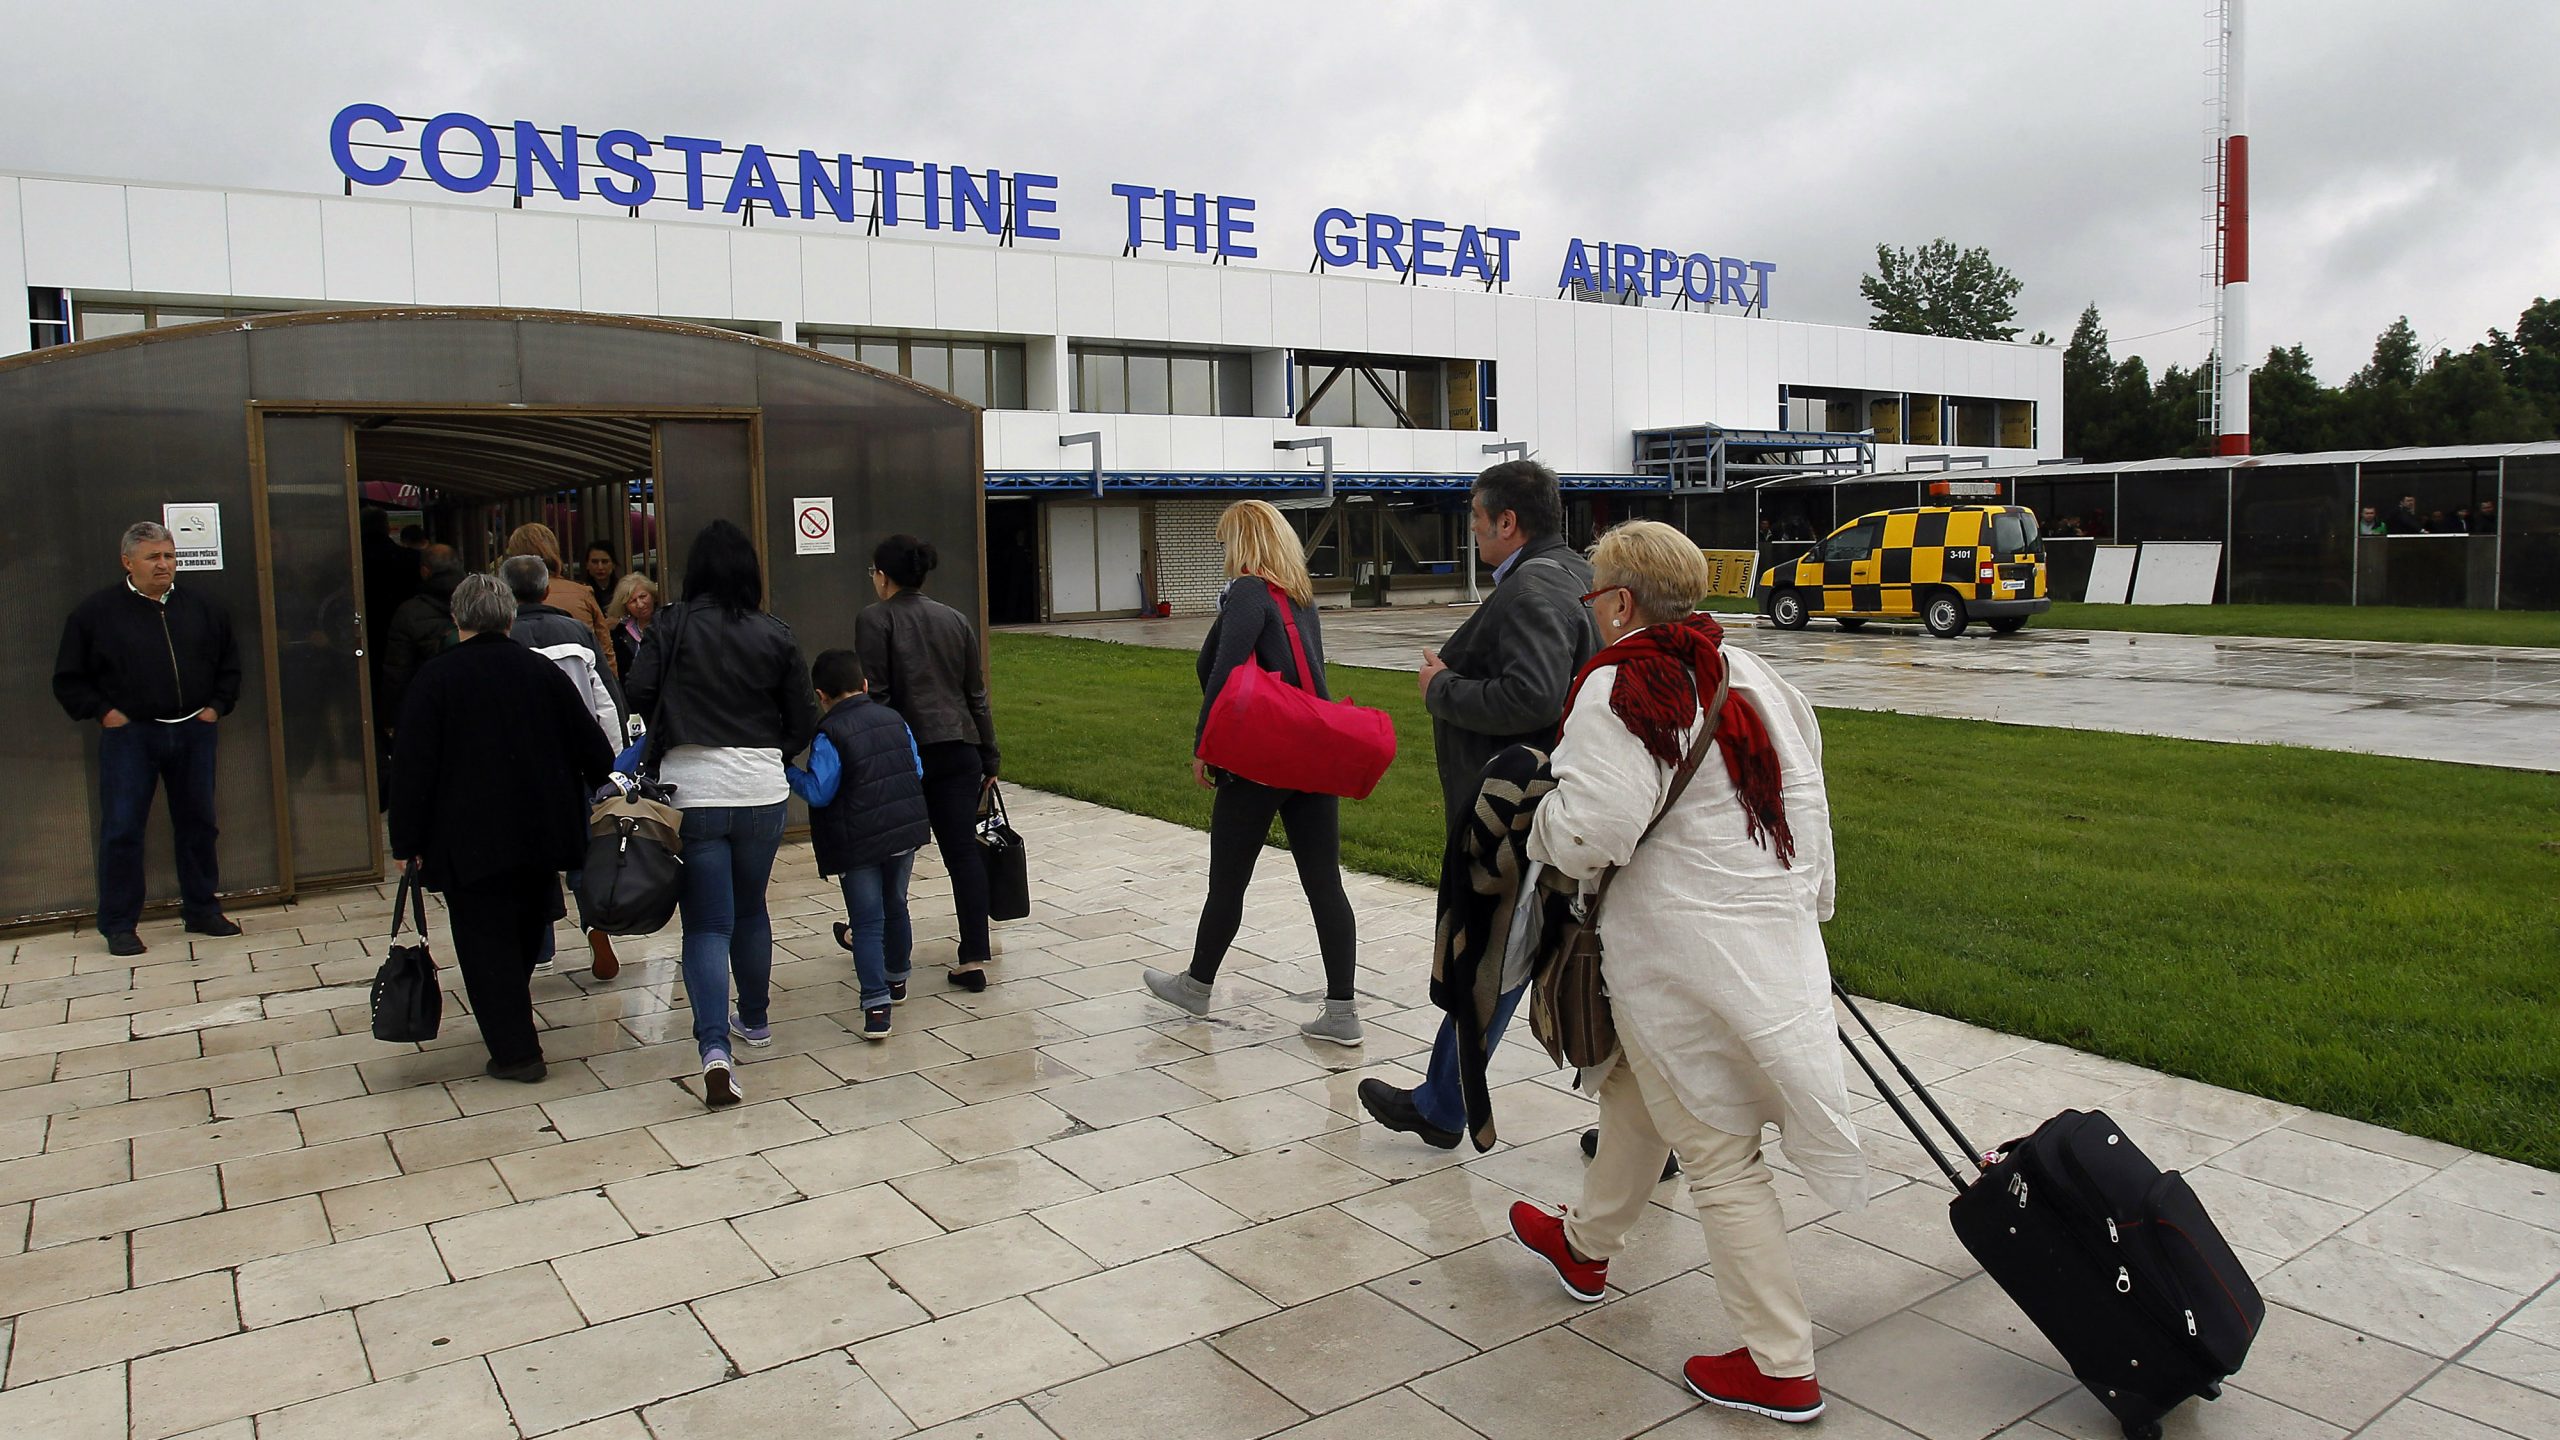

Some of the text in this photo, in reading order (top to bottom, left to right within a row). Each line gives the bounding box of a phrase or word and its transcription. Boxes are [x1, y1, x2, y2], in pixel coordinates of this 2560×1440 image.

[330, 103, 1776, 309] CONSTANTINE THE GREAT AIRPORT
[1950, 550, 1971, 559] 3-101
[1712, 559, 1724, 592] Alumil
[1739, 560, 1751, 593] Alumil
